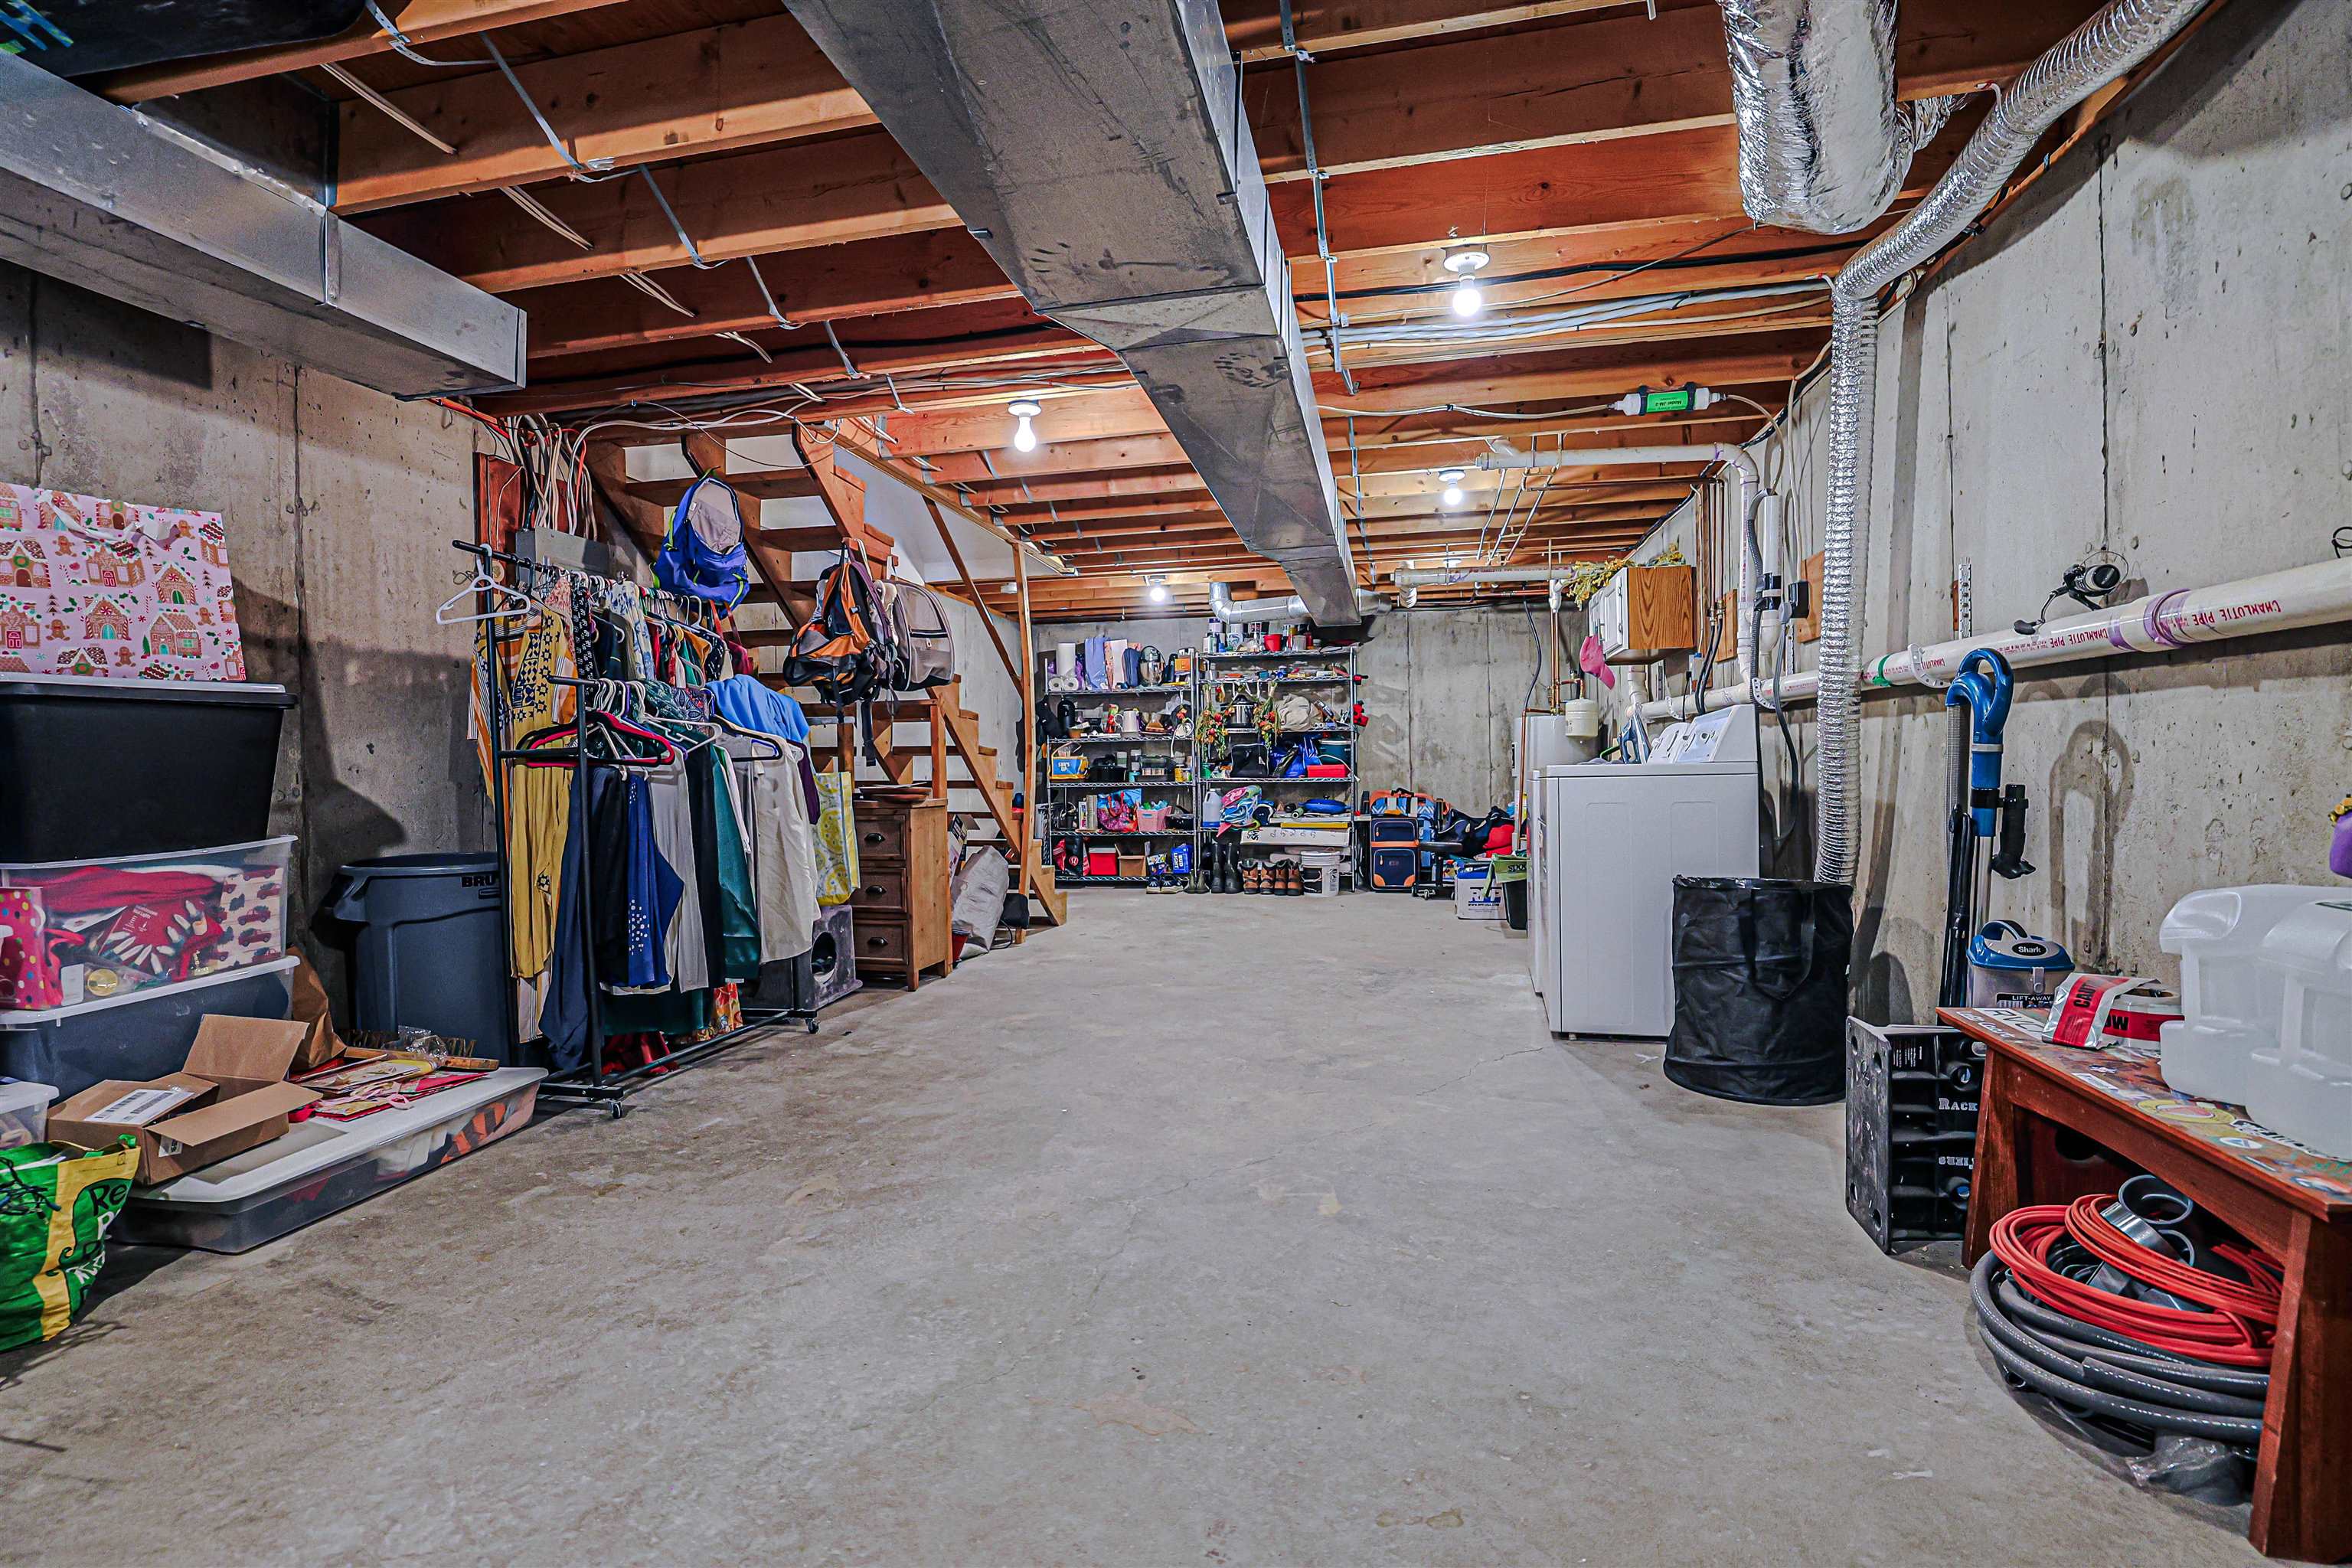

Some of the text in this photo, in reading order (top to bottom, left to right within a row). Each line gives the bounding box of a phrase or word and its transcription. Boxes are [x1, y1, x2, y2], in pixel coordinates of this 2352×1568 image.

[2192, 599, 2282, 626] CHARLOTTE PIPE
[2050, 637, 2066, 648] PIPE
[2069, 628, 2109, 645] CHARLOTTE
[460, 875, 495, 887] BRU
[2017, 945, 2042, 953] Shark
[2073, 980, 2097, 1008] CAUT
[1984, 1009, 2047, 1033] RVC
[1939, 1097, 1978, 1112] RACK
[90, 1184, 127, 1217] Re
